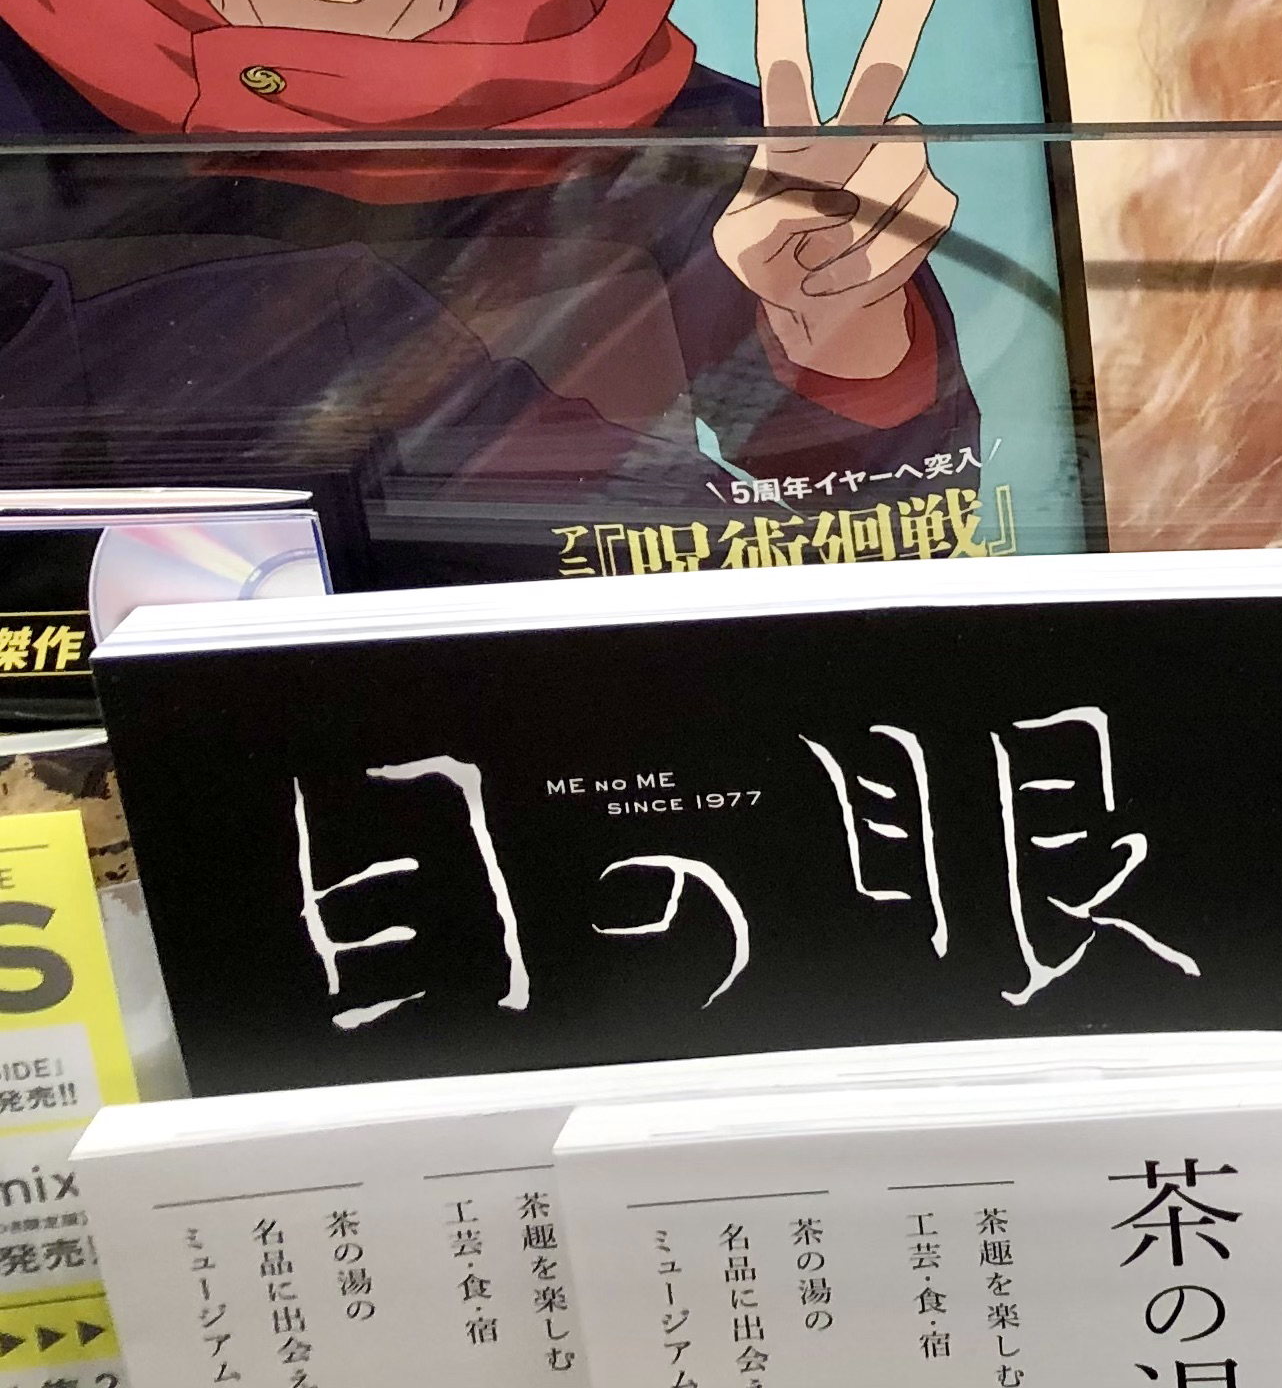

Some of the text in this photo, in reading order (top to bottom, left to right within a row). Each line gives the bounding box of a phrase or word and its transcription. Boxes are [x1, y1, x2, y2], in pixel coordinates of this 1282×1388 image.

[730, 446, 982, 504] 5周年イヤーへ突入
[546, 778, 586, 795] ME
[636, 771, 676, 789] ME
[607, 790, 762, 815] SINCE 1977
[186, 1228, 241, 1382] ミュージアム
[328, 1210, 376, 1321] 茶の湯の
[519, 1192, 576, 1372] 茶趣を楽しむ
[789, 1217, 834, 1332] 茶の湯の
[975, 1207, 1025, 1388] 茶趣を楽しむ
